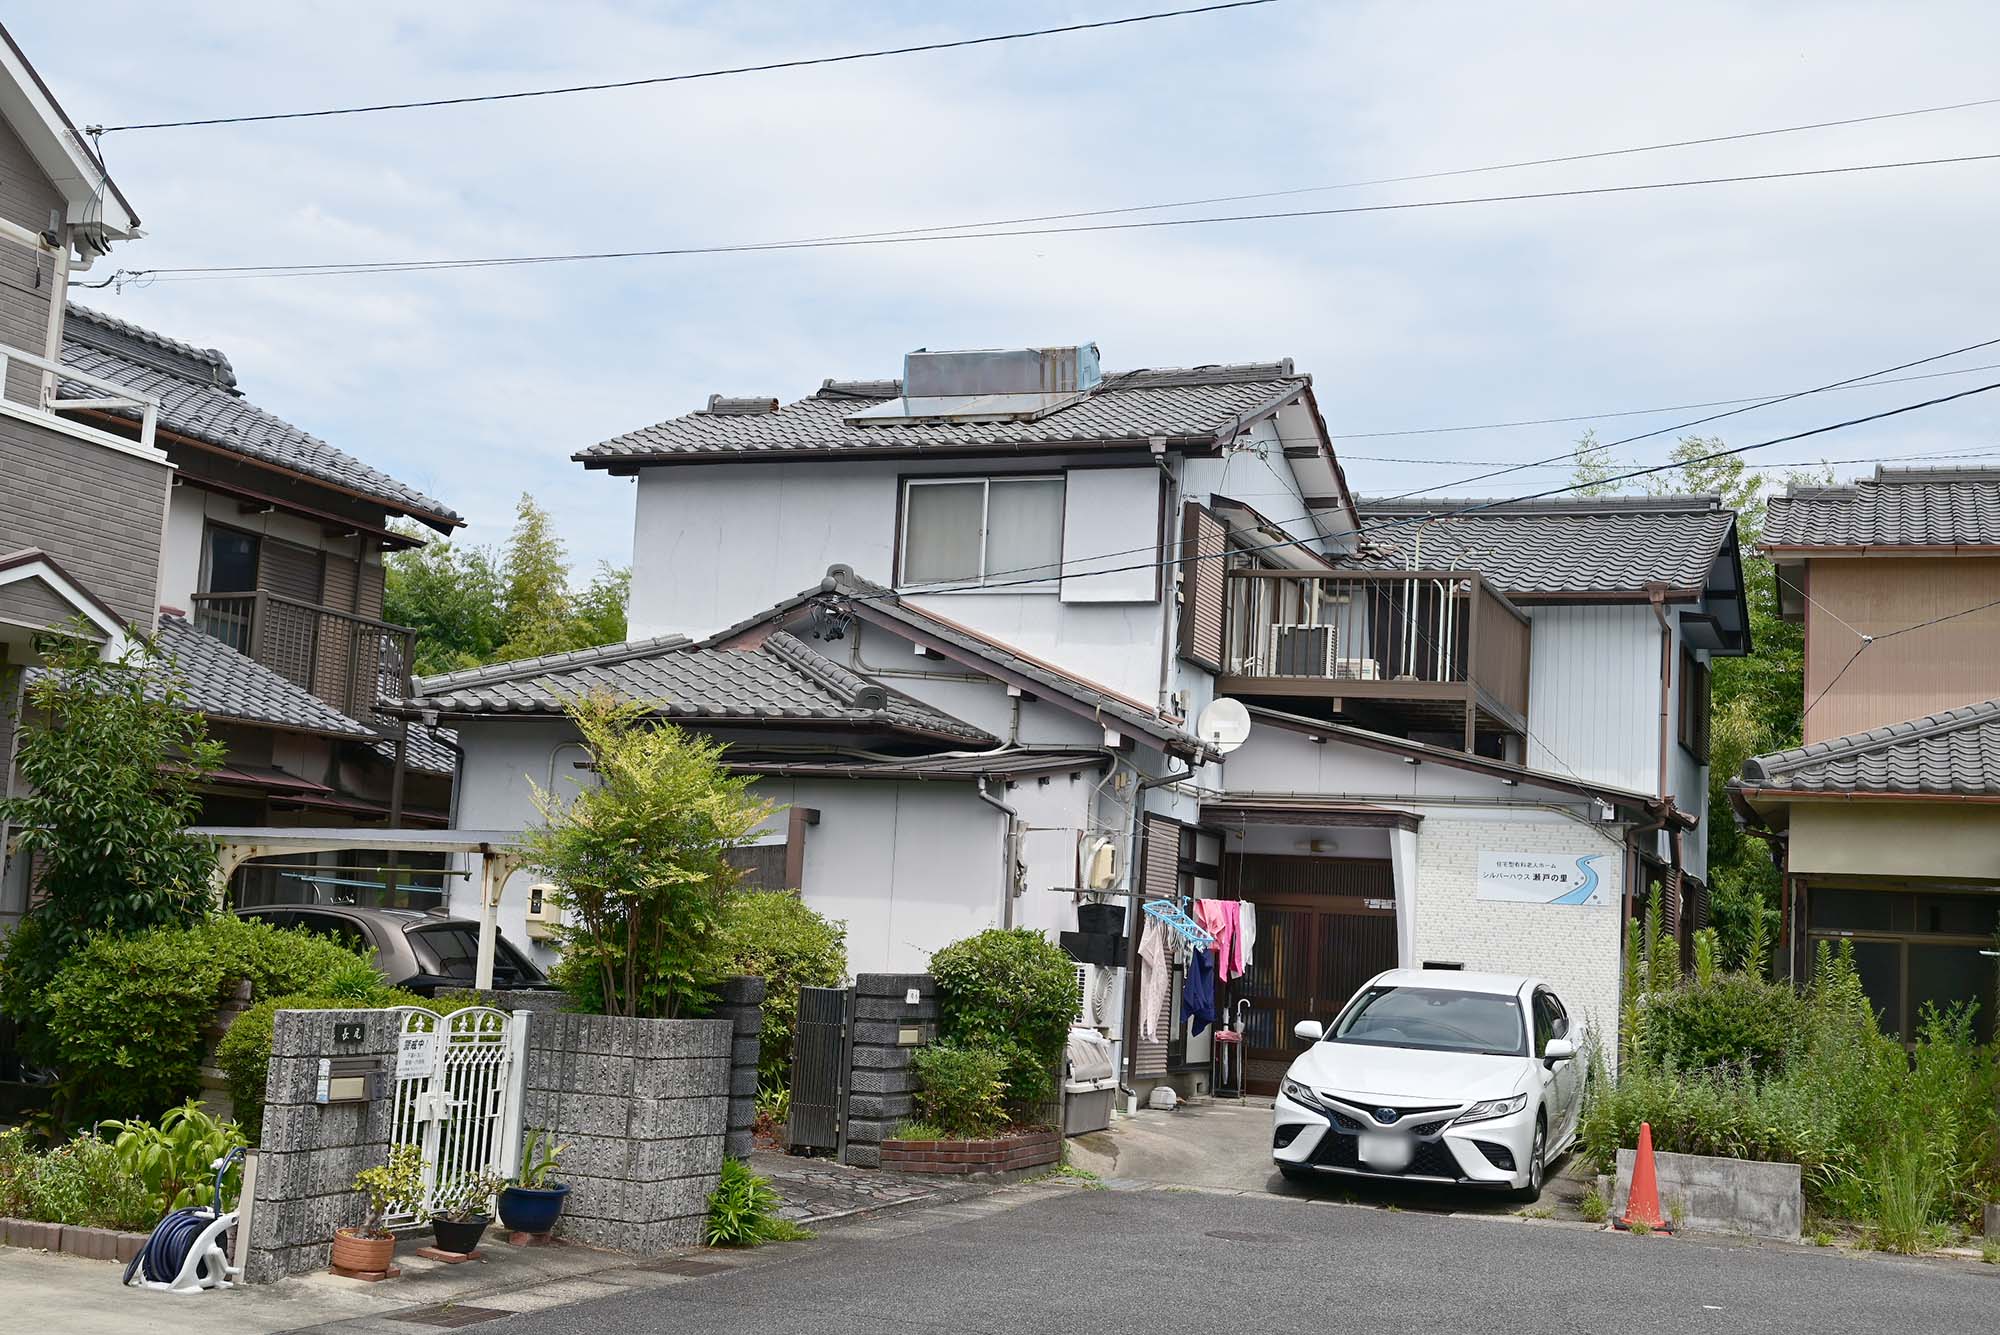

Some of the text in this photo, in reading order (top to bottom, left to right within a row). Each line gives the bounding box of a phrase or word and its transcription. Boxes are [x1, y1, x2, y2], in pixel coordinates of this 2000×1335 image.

[1482, 872, 1530, 880] シルバーハウス
